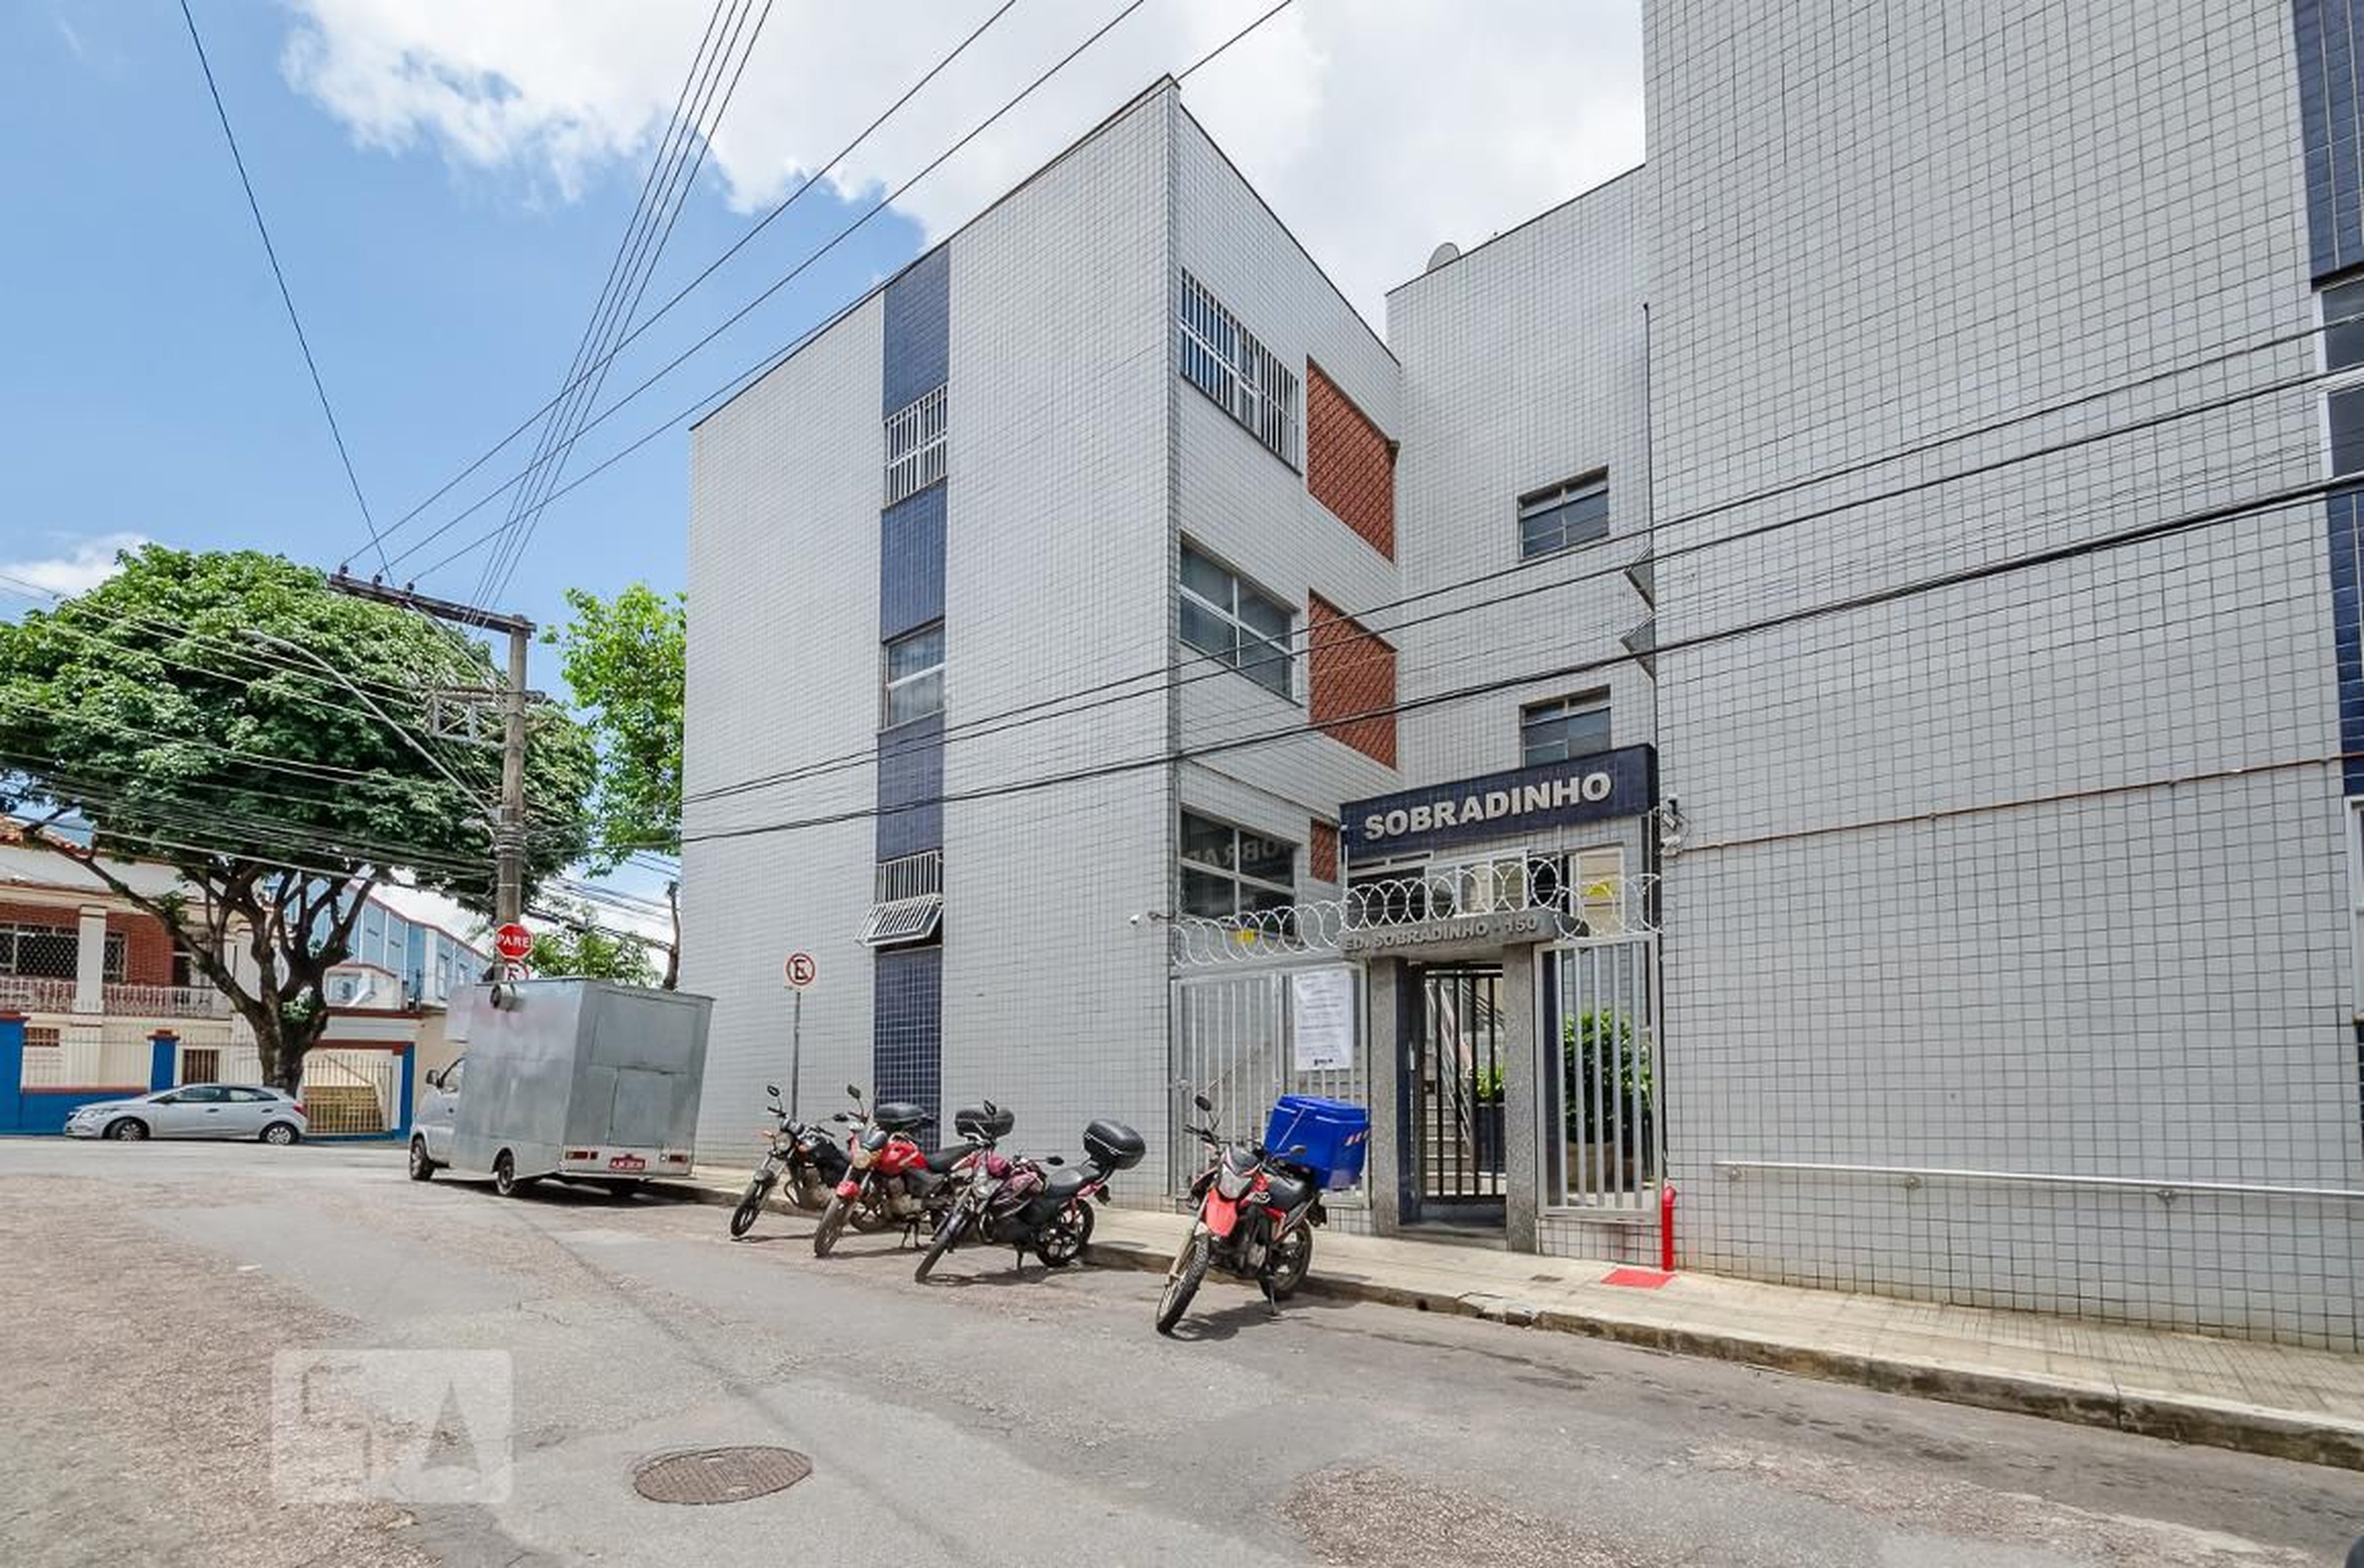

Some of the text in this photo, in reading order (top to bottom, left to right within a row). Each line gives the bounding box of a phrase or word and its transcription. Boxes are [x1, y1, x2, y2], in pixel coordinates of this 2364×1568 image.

[1364, 771, 1611, 840] SOBRADINHO
[497, 933, 529, 949] PARE
[1373, 922, 1489, 947] SOBRADINHO
